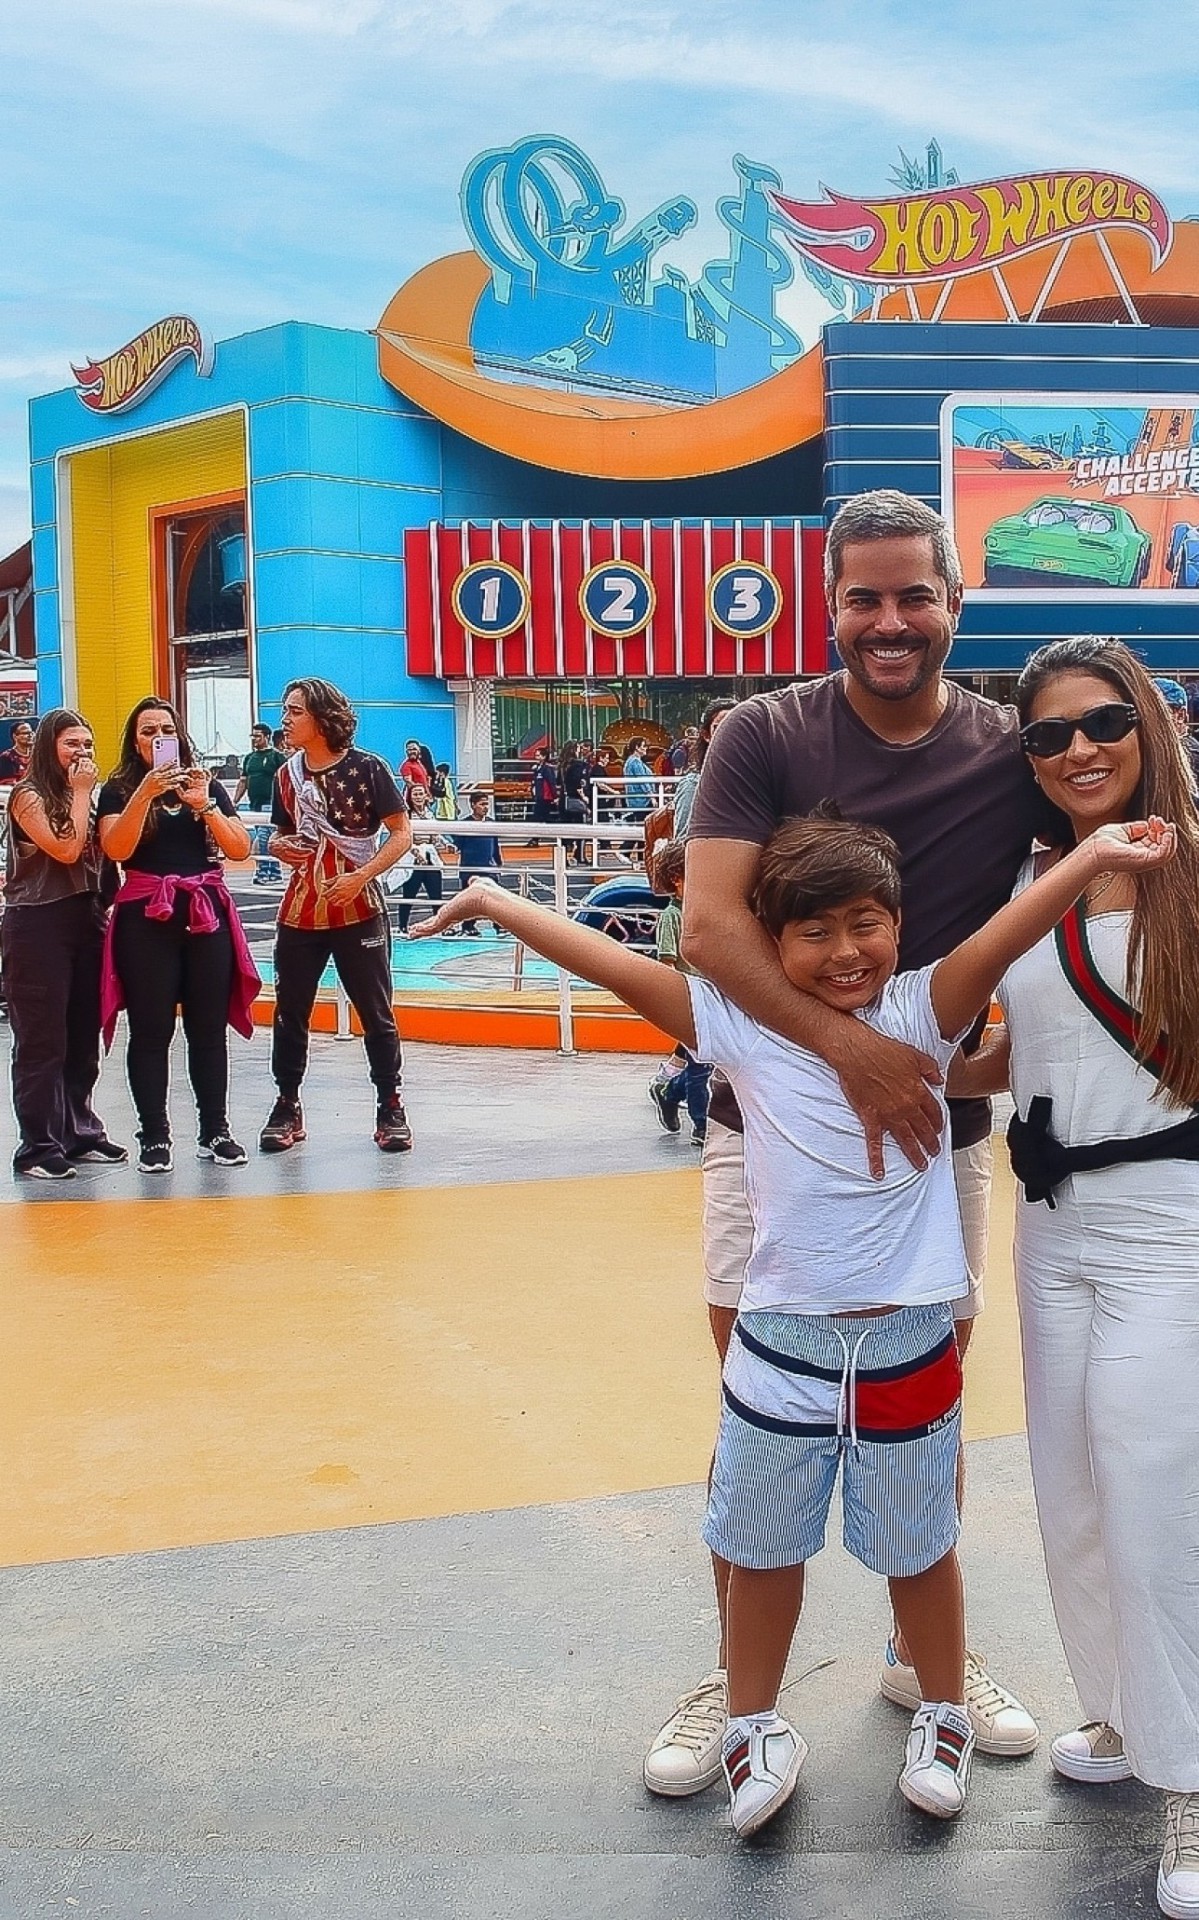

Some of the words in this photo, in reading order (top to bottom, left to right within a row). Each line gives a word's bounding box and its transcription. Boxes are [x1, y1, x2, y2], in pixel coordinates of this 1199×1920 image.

[1077, 447, 1199, 479] CHALLENGE
[479, 576, 501, 622] 1
[601, 576, 638, 622] 2
[727, 576, 762, 622] 3
